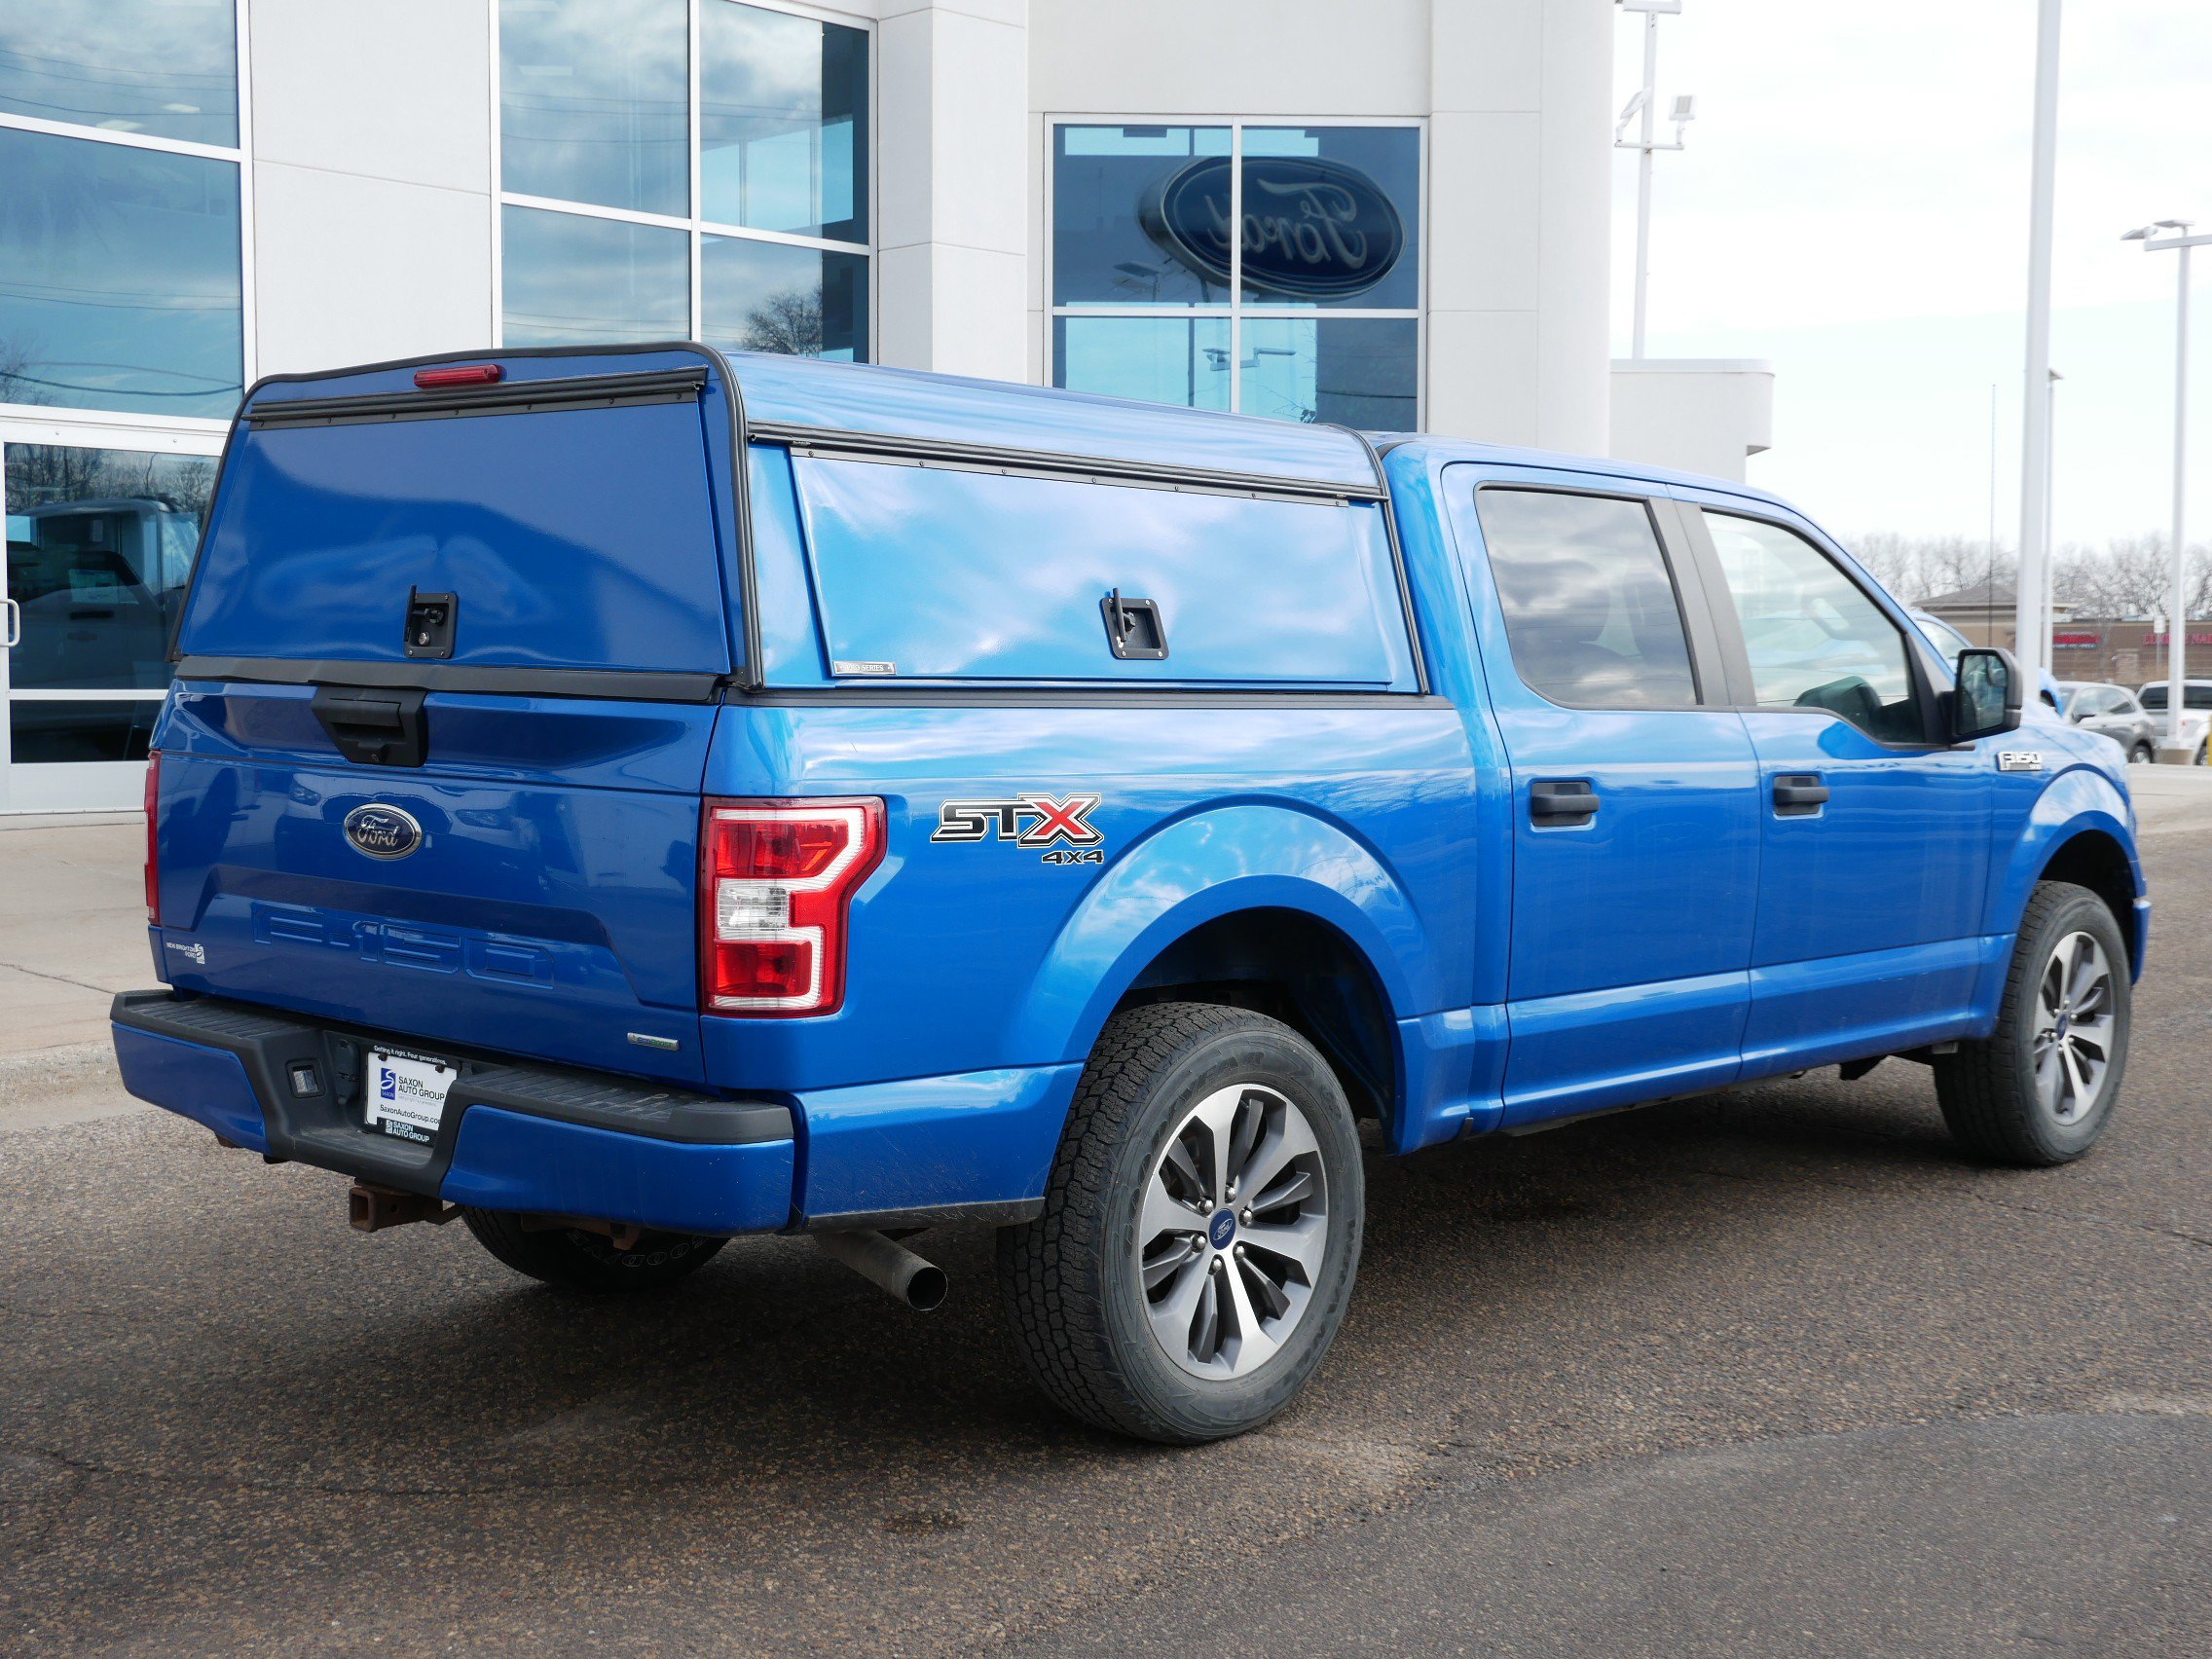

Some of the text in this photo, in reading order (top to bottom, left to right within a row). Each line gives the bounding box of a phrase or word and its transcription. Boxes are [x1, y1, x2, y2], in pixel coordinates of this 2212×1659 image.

[930, 793, 1104, 848] STX
[356, 814, 400, 847] Ford
[250, 899, 556, 990] F-150
[398, 1076, 424, 1088] SAXON
[398, 1085, 418, 1095] AUTO
[419, 1088, 445, 1101] GROUP
[392, 1121, 414, 1132] SAXON
[392, 1128, 430, 1143] AUTO GROUP
